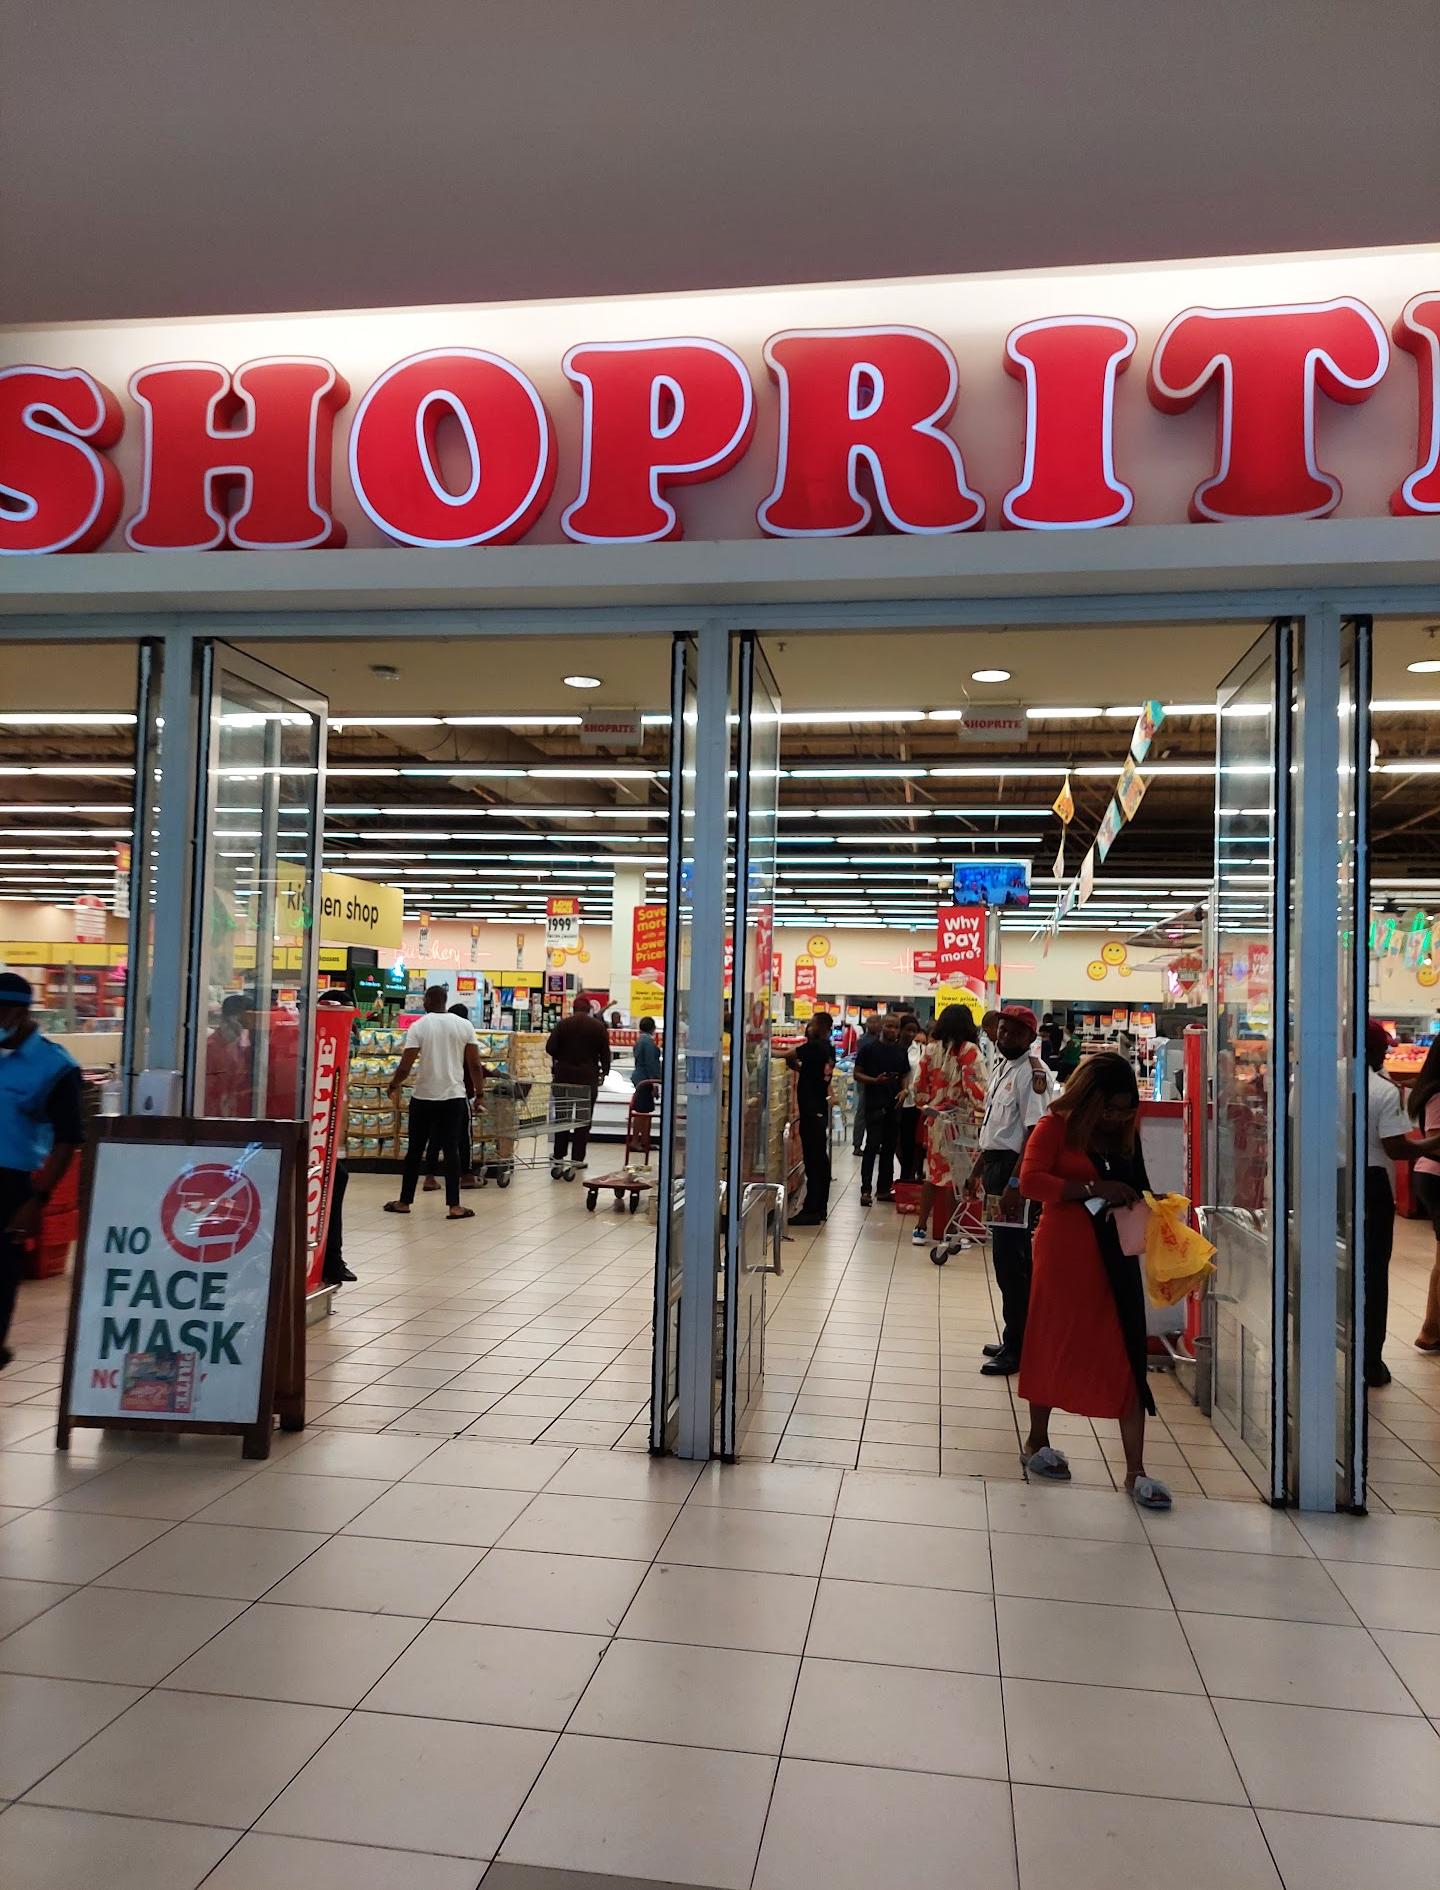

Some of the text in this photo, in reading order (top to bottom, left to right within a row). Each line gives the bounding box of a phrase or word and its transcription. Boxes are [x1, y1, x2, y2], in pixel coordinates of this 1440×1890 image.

[0, 291, 1440, 554] SHOPRIT
[583, 724, 637, 733] SHOPRITE
[964, 719, 1022, 728] SHOPRITE
[346, 895, 379, 930] shop
[944, 915, 980, 931] Why
[636, 940, 666, 951] Lowe
[943, 932, 980, 951] Pay
[940, 947, 982, 963] more?
[105, 1226, 151, 1254] NO
[103, 1268, 228, 1311] FACE
[98, 1317, 245, 1365] MASK
